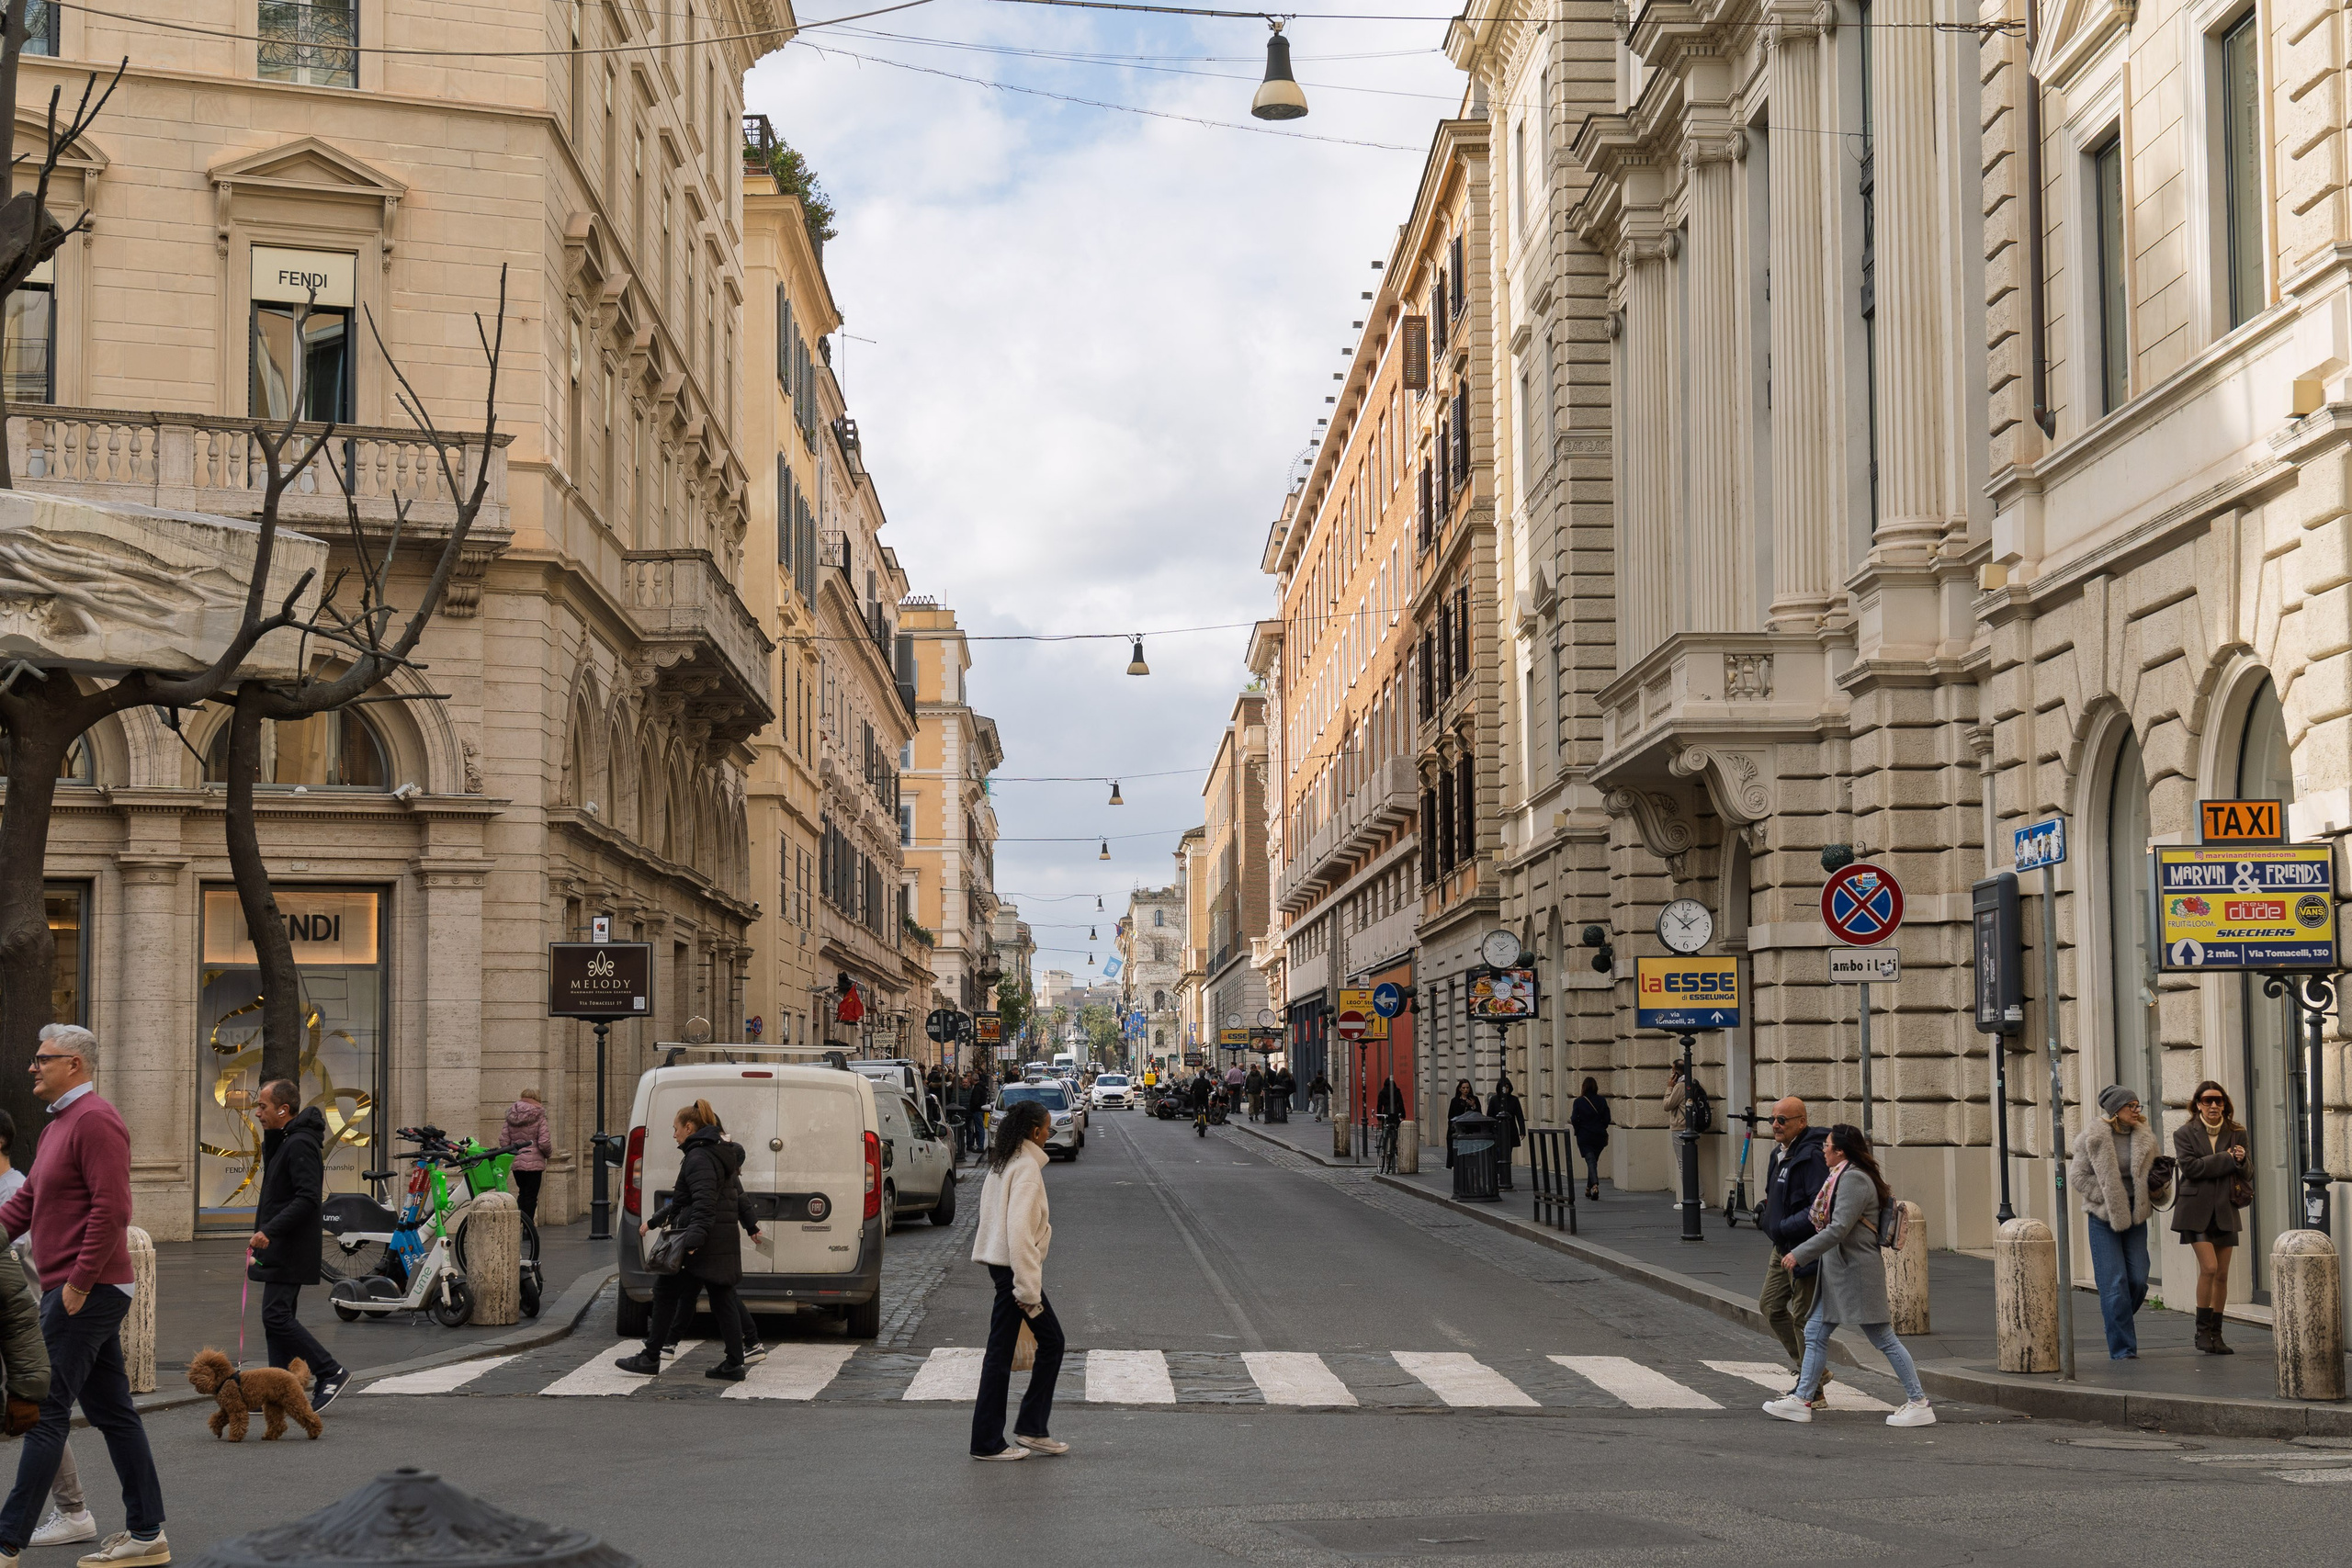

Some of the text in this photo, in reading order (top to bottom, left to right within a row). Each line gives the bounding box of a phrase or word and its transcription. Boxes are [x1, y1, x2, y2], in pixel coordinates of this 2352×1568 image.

[279, 270, 327, 288] FENDI
[2207, 806, 2274, 836] TAXI
[2233, 861, 2263, 894] &
[2266, 863, 2323, 885] FRIENDS
[2299, 906, 2324, 916] VANS
[248, 914, 340, 941] NDI
[1663, 921, 1668, 930] 9
[1704, 922, 1709, 931] 3
[2216, 928, 2297, 937] SKECHERS
[1682, 941, 1689, 949] 6
[2216, 950, 2238, 958] min.
[2266, 949, 2312, 958] Tomacelli,
[2313, 949, 2329, 957] 130
[1833, 959, 1863, 971] ambo
[1867, 959, 1871, 971] i
[571, 979, 631, 988] MELODY
[811, 1202, 822, 1212] FIAT
[413, 1266, 433, 1295] Lime
